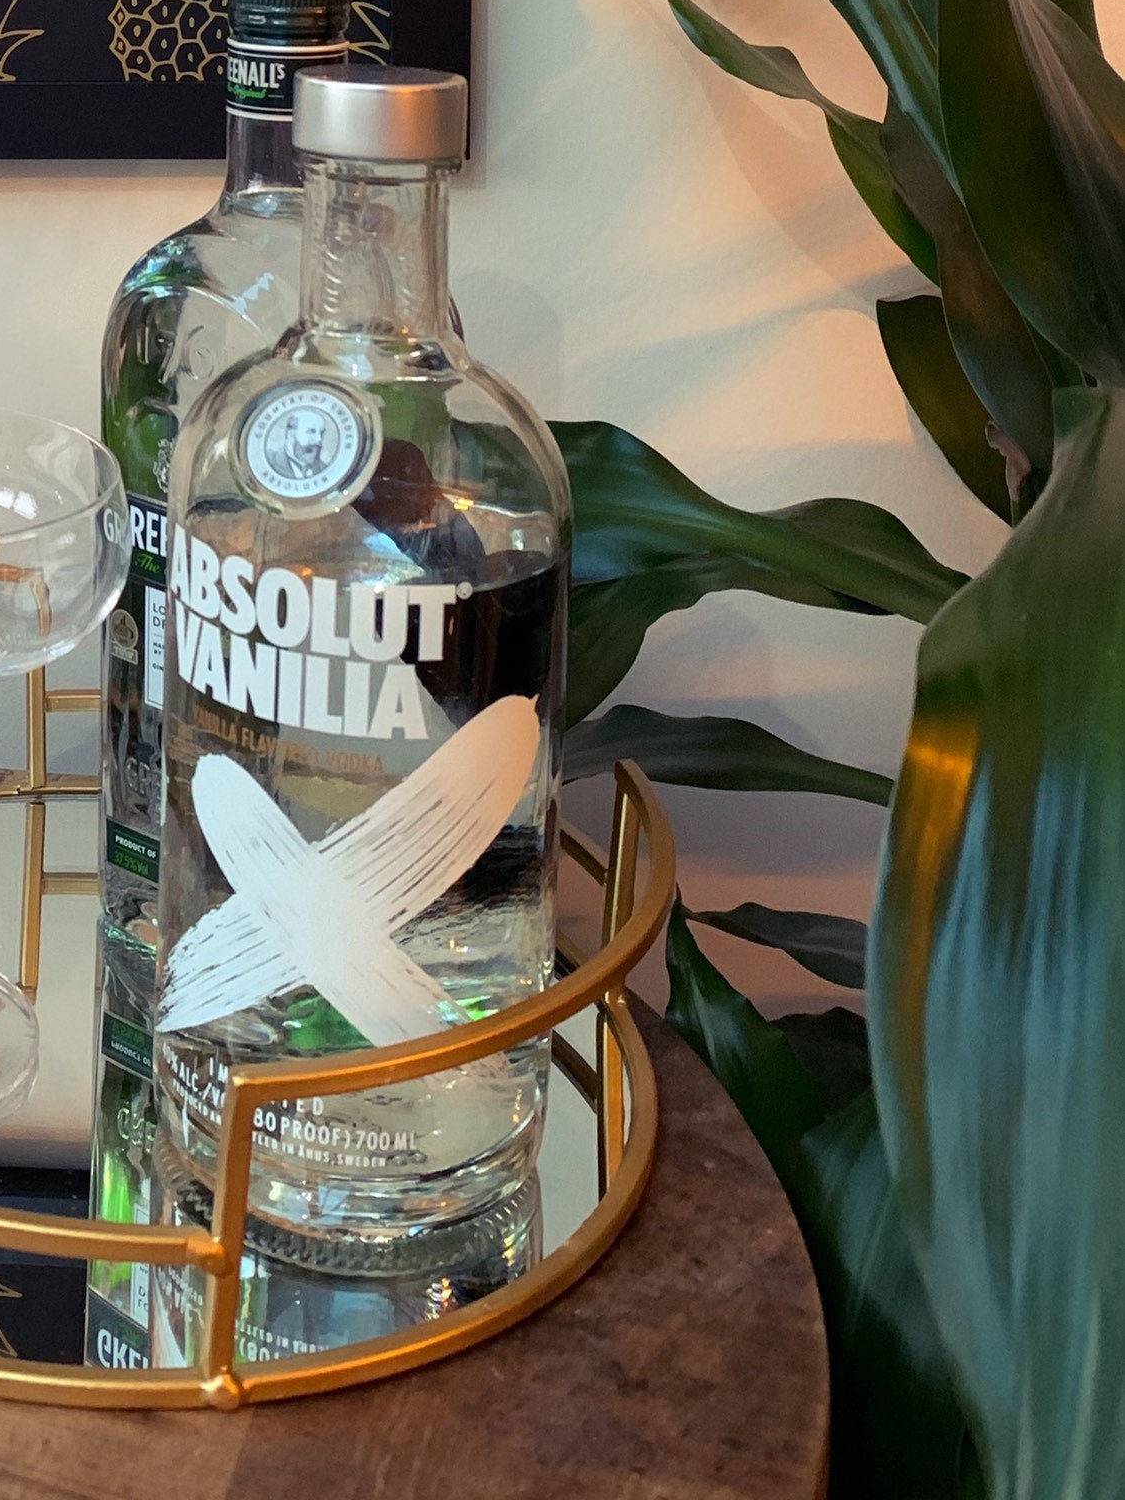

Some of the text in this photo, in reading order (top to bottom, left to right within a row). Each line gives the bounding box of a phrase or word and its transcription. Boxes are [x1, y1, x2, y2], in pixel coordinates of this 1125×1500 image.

[176, 600, 429, 740] VANILIA
[326, 751, 384, 773] VODKA
[115, 835, 145, 854] PRODUCT
